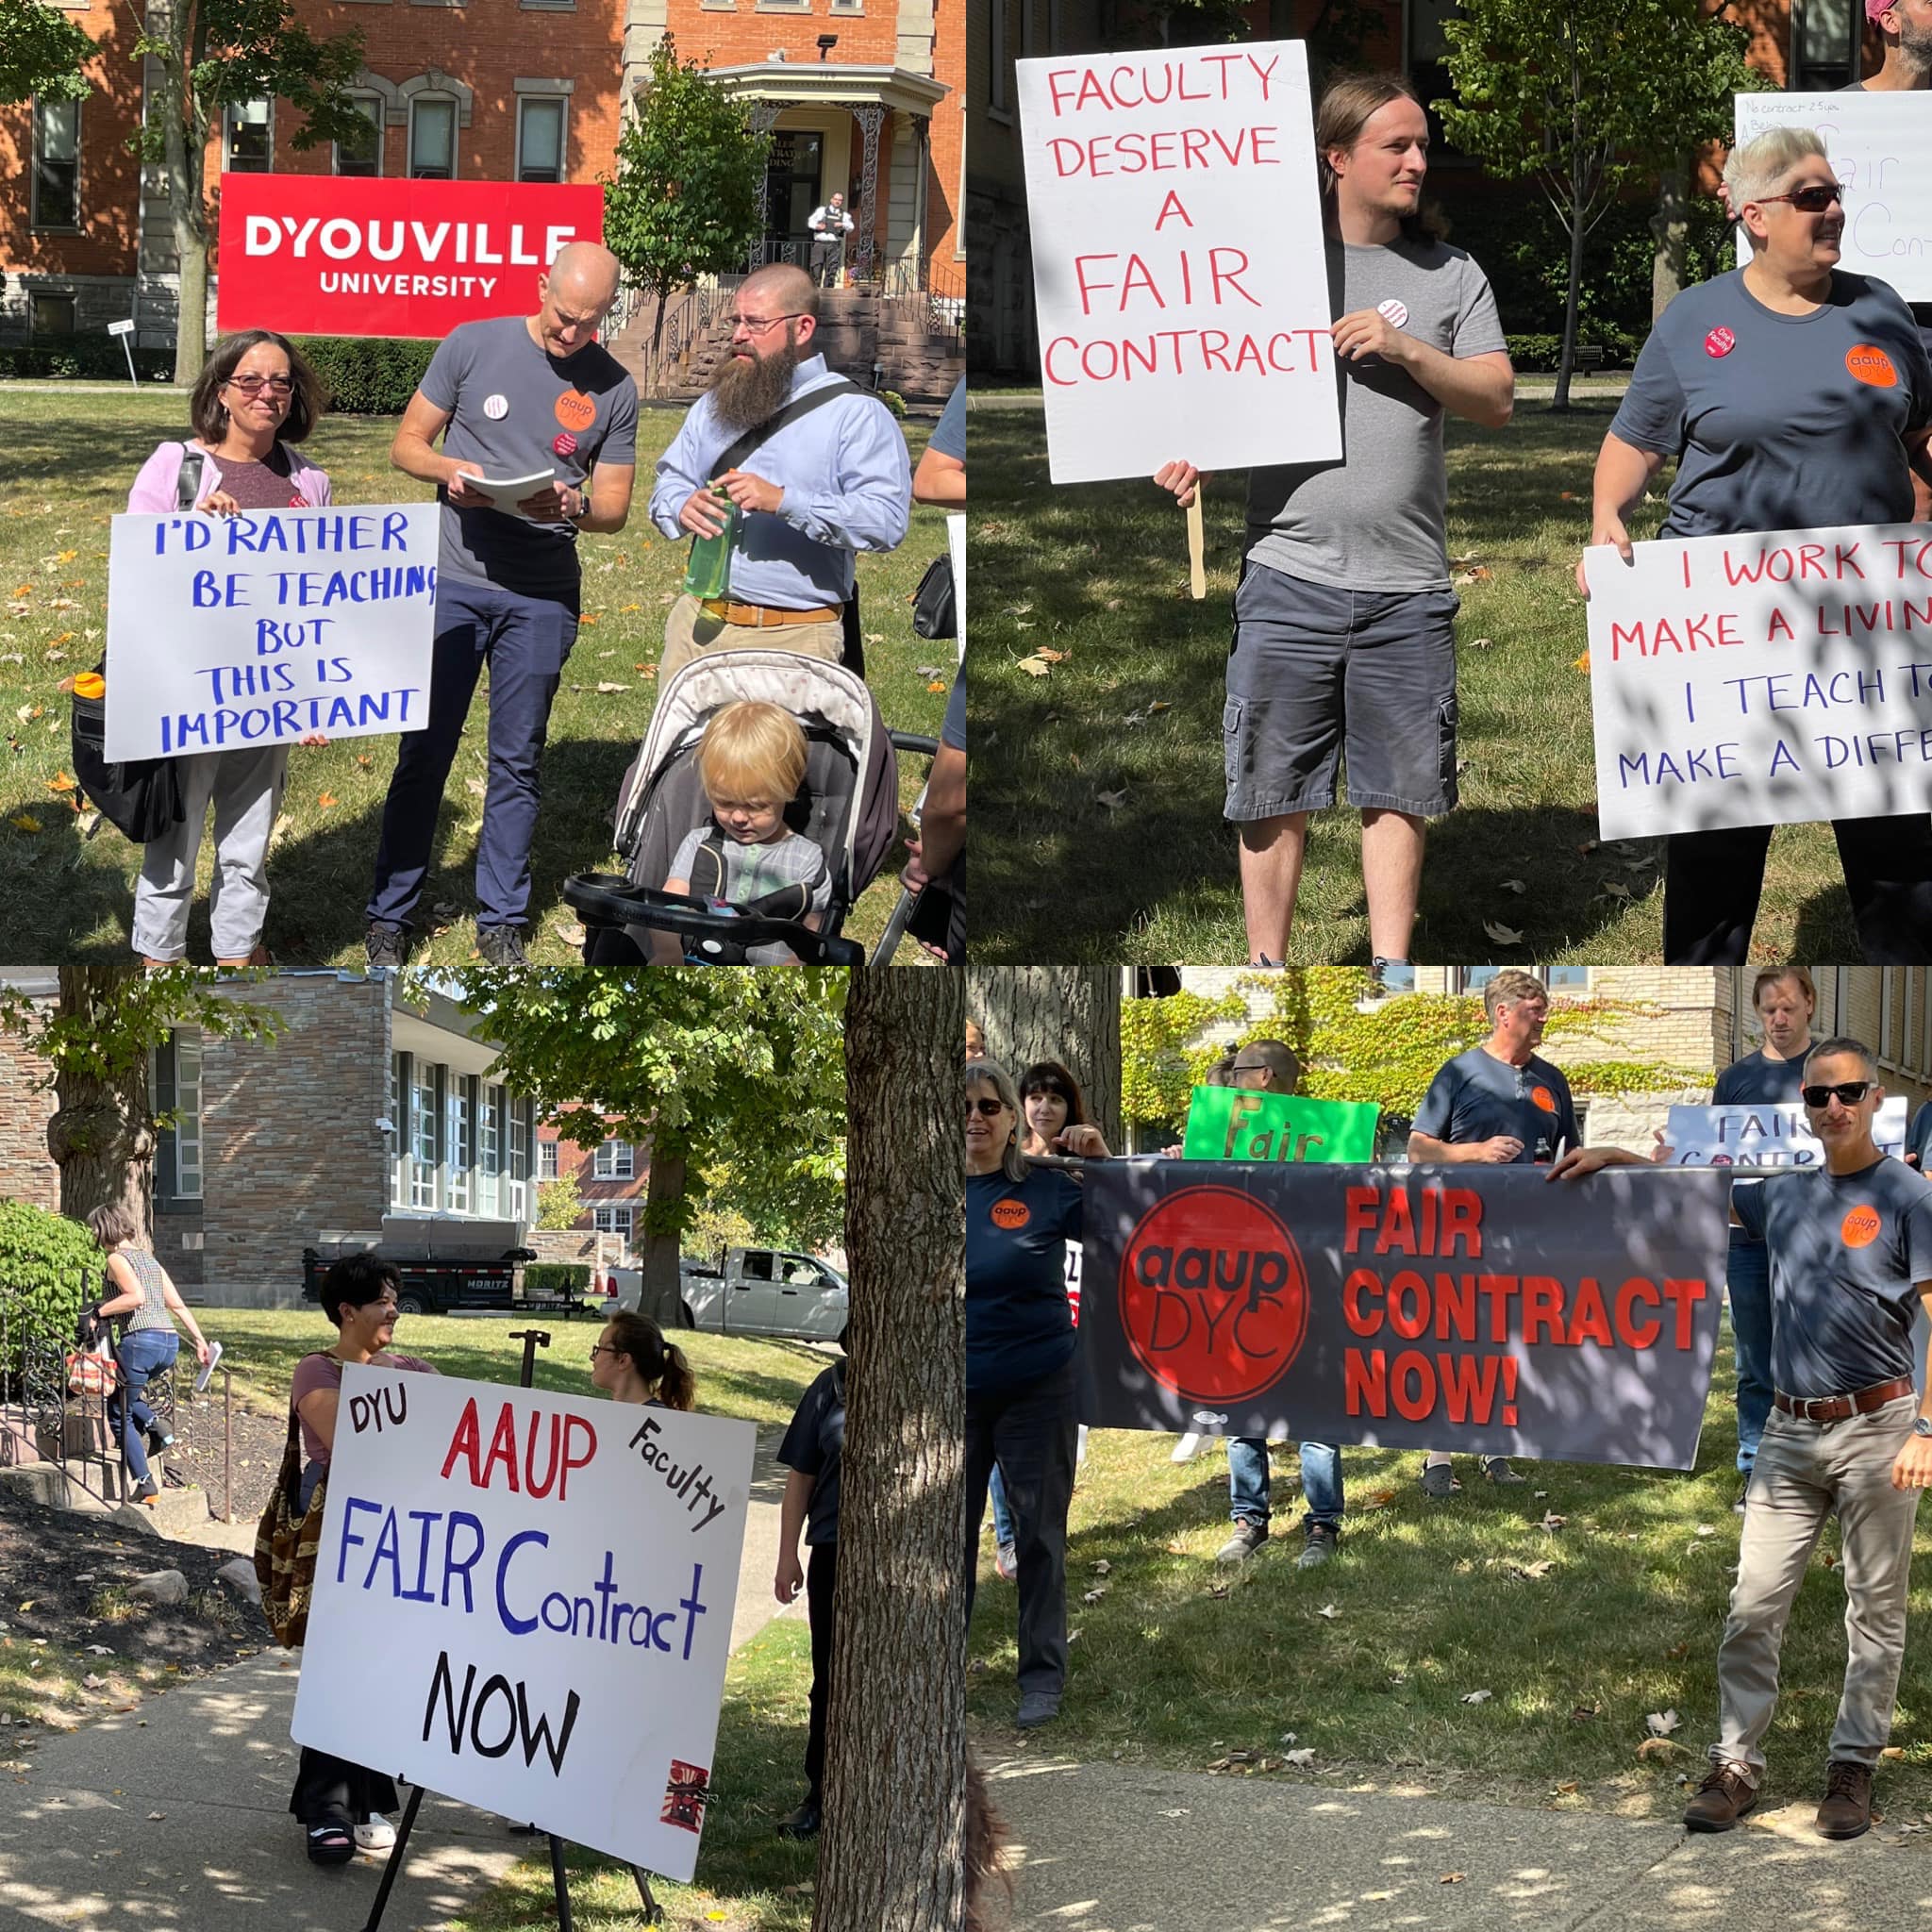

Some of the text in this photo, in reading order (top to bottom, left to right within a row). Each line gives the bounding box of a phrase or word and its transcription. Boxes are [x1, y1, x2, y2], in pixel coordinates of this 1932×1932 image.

[1048, 54, 1280, 117] FACULTY
[1046, 127, 1281, 177] DESERVE
[1155, 190, 1193, 231] A
[1854, 202, 1932, 258] Con
[245, 215, 575, 265] DYOUVILLE
[320, 272, 497, 298] UNIVERSITY
[1074, 247, 1262, 315] FAIR
[1044, 329, 1331, 385] CONTRACT
[1707, 330, 1730, 352] Faculty
[1718, 328, 1731, 342] One
[1851, 356, 1889, 369] aaup
[560, 396, 592, 415] aaup
[156, 512, 408, 556] I'D RATHER
[192, 565, 437, 608] BE TEACHING
[1683, 550, 1691, 589] I
[1724, 542, 1866, 587] WORK
[256, 618, 335, 656] BUT
[1611, 613, 1744, 661] MAKE
[1767, 608, 1795, 641] A
[194, 657, 353, 706] THIS IS
[1686, 663, 1932, 724] I TEACH T
[160, 689, 421, 754] IMPORTANT
[1619, 742, 1742, 789] MAKE
[1770, 740, 1801, 777] A
[1224, 1093, 1324, 1162] Fair
[1679, 1142, 1903, 1166] CONTRT
[995, 1208, 1026, 1217] aaup
[1343, 1187, 1485, 1258] FAIR
[1847, 1216, 1877, 1230] aaup
[467, 1279, 509, 1290] MORITZ
[1136, 1244, 1290, 1313] aaup
[1150, 1290, 1284, 1359] DYC
[1342, 1269, 1707, 1350] CONTRACT
[1343, 1348, 1519, 1426] NOW!
[349, 1382, 725, 1532] DYU AAUP Faculty
[337, 1496, 708, 1660] FAIR Contract
[422, 1651, 581, 1778] NOW
